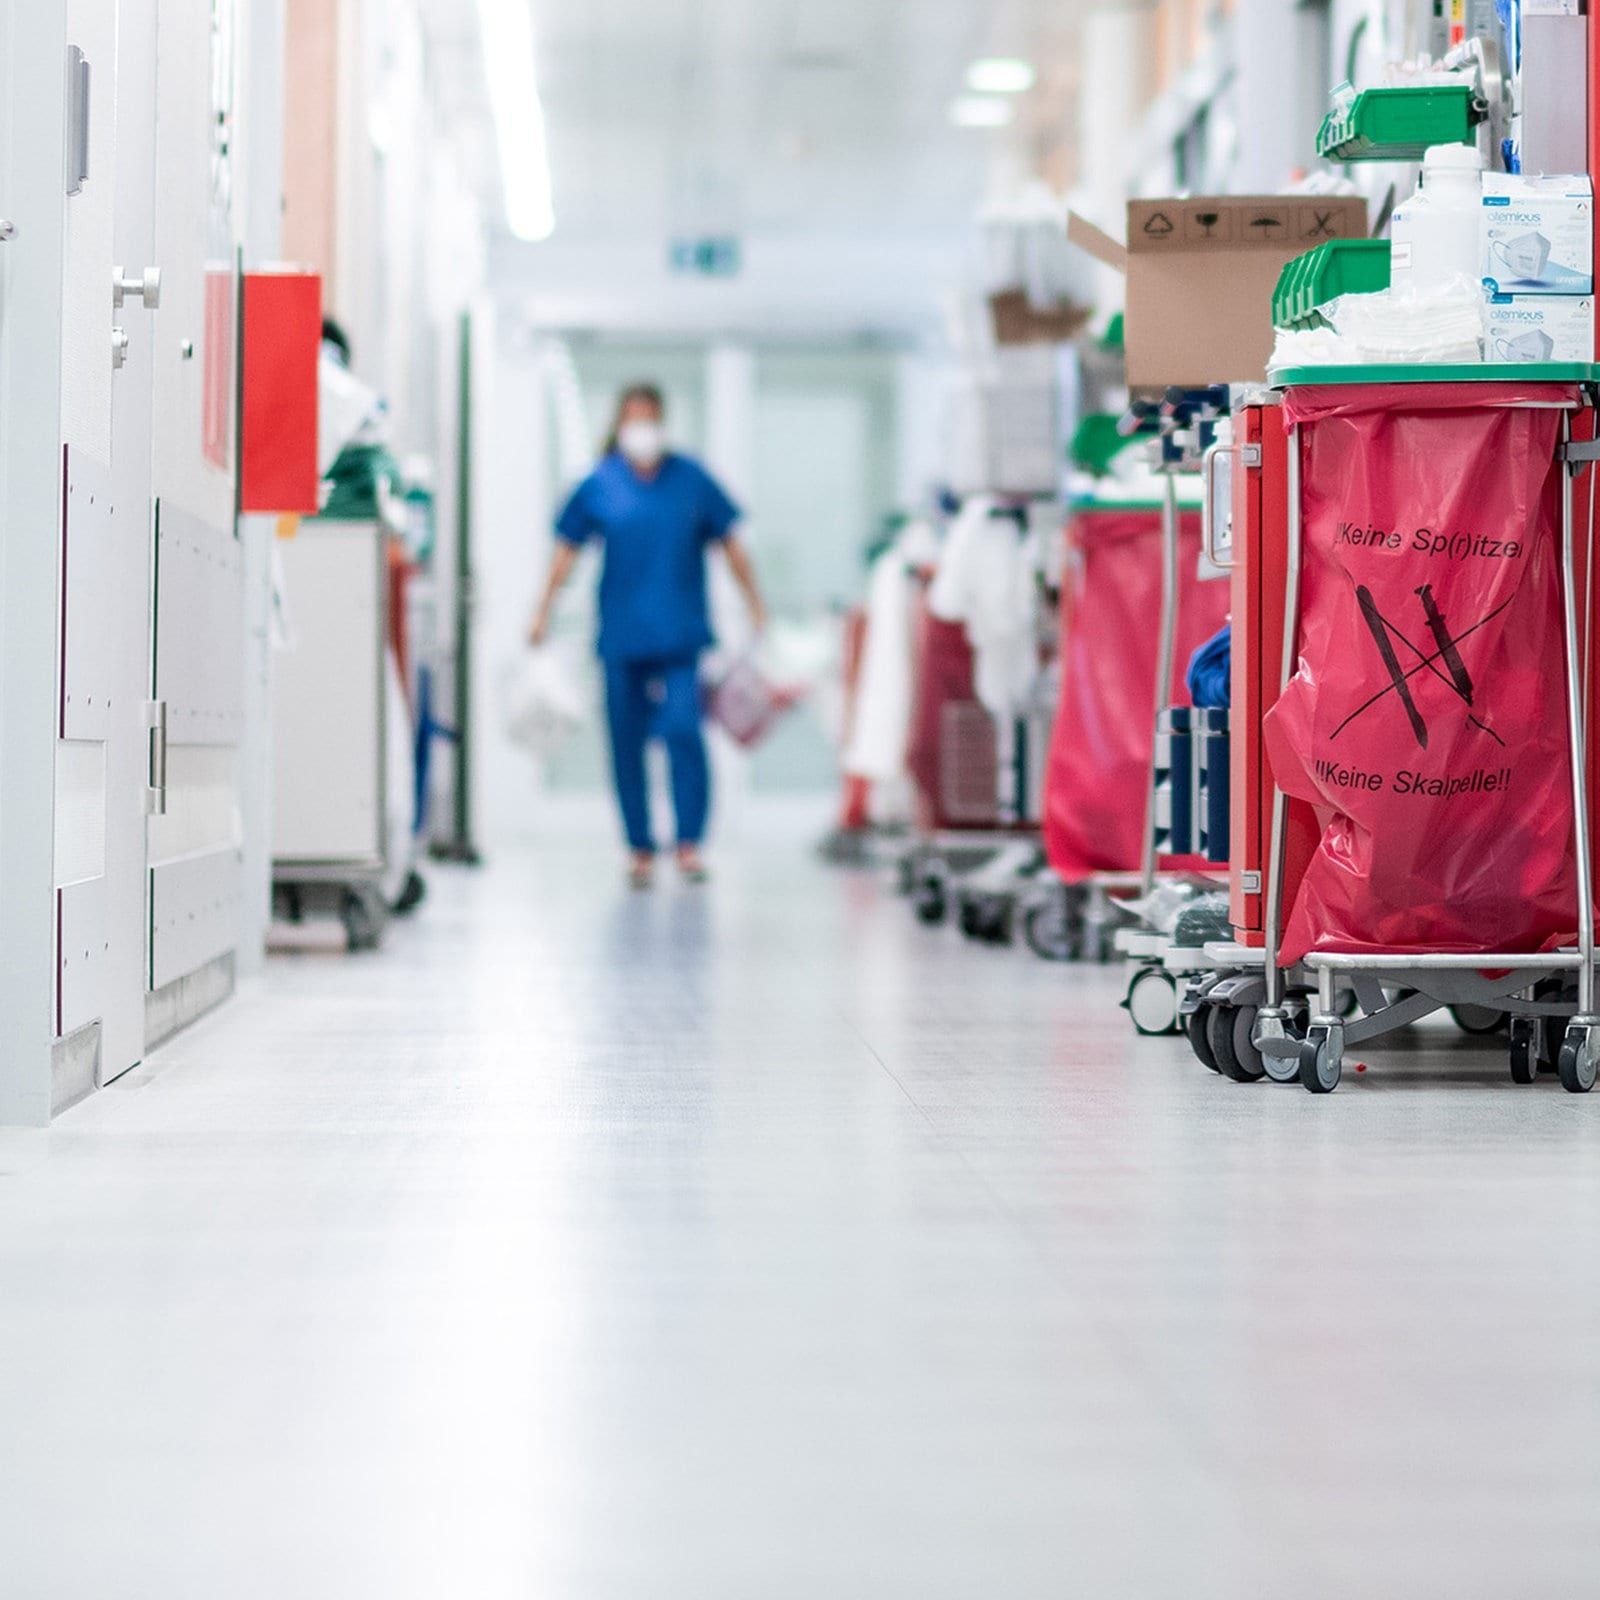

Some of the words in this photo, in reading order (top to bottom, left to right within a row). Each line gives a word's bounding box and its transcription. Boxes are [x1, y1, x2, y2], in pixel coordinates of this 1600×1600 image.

[1412, 528, 1523, 560] Sp(r)itze
[1315, 759, 1383, 791] !!Keine
[1392, 768, 1511, 800] Skalpelle!!
